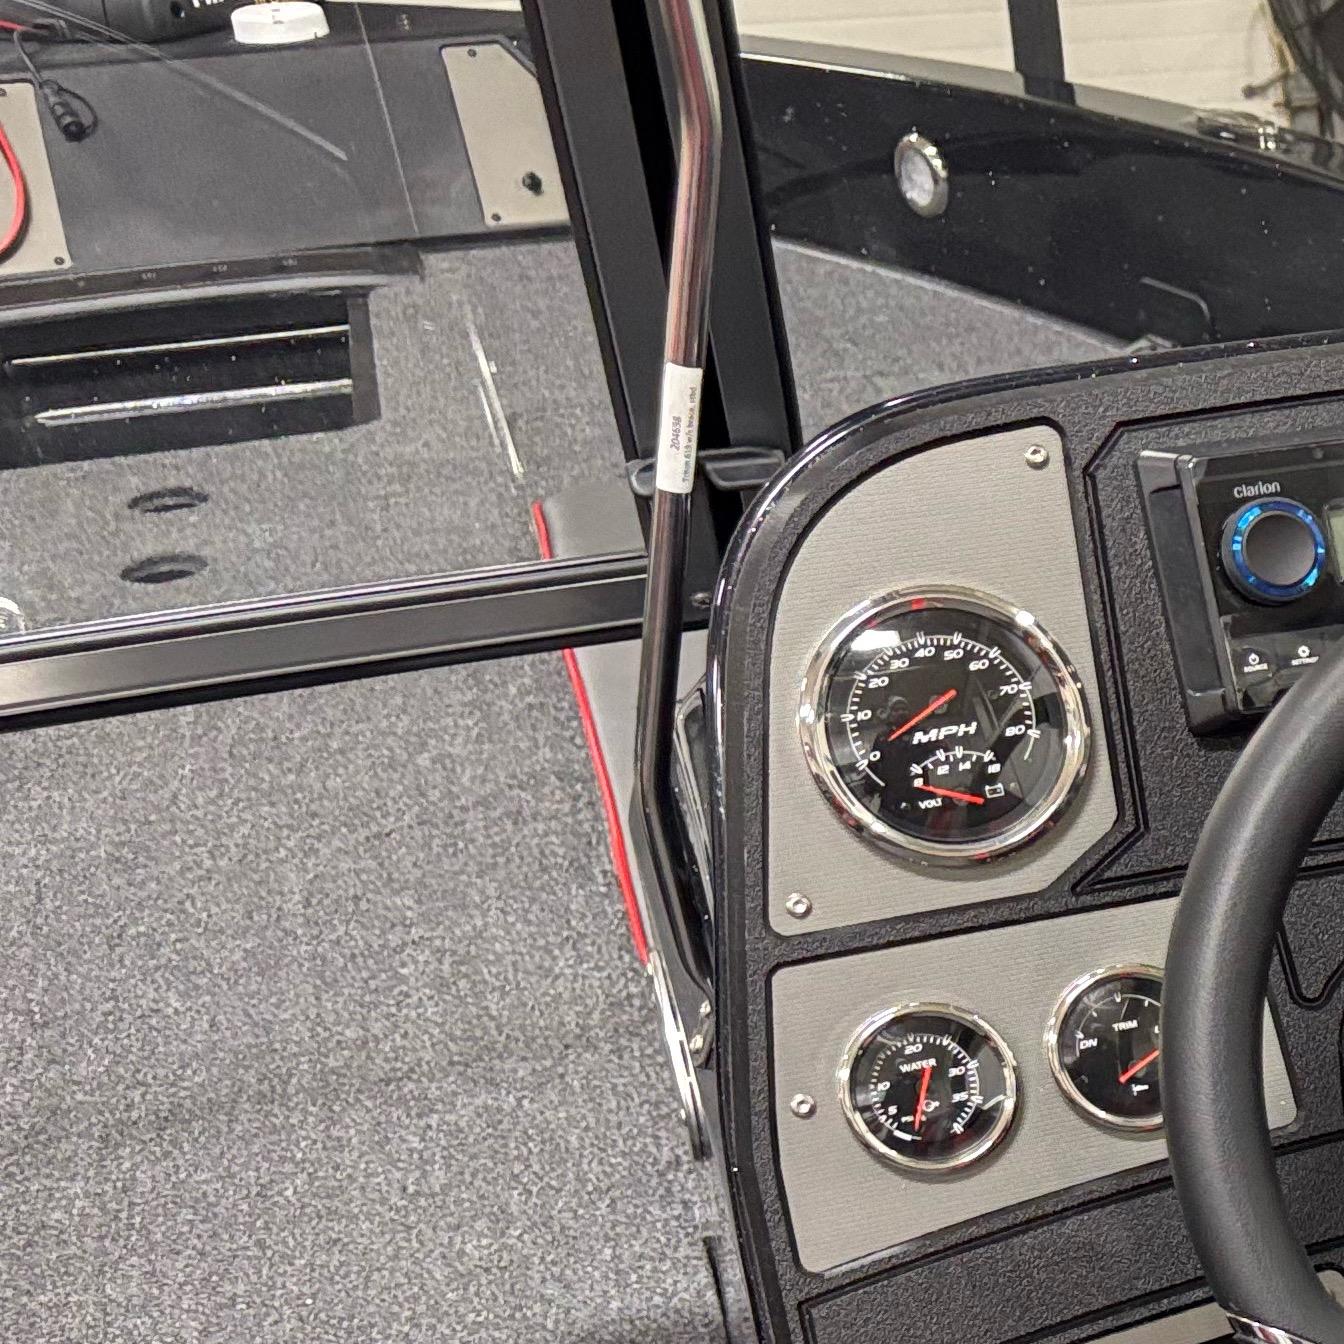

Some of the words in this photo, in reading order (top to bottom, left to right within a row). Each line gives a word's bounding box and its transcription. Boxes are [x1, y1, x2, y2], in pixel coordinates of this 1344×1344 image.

[915, 647, 936, 658] 40
[944, 649, 964, 660] 50
[890, 658, 910, 670] 30
[969, 659, 989, 671] 60
[868, 675, 890, 688] 20
[999, 684, 1018, 696] 70
[856, 709, 872, 721] 10
[912, 722, 978, 745] MPH
[1005, 725, 1025, 737] 80
[869, 751, 881, 761] 0
[918, 798, 944, 809] VOLT
[1112, 1020, 1138, 1032] TRIM
[904, 1043, 922, 1055] 20
[1080, 1038, 1098, 1049] DN
[899, 1058, 937, 1072] WATER
[948, 1067, 965, 1078] 30
[877, 1082, 891, 1091] 10
[888, 1106, 898, 1115] 5
